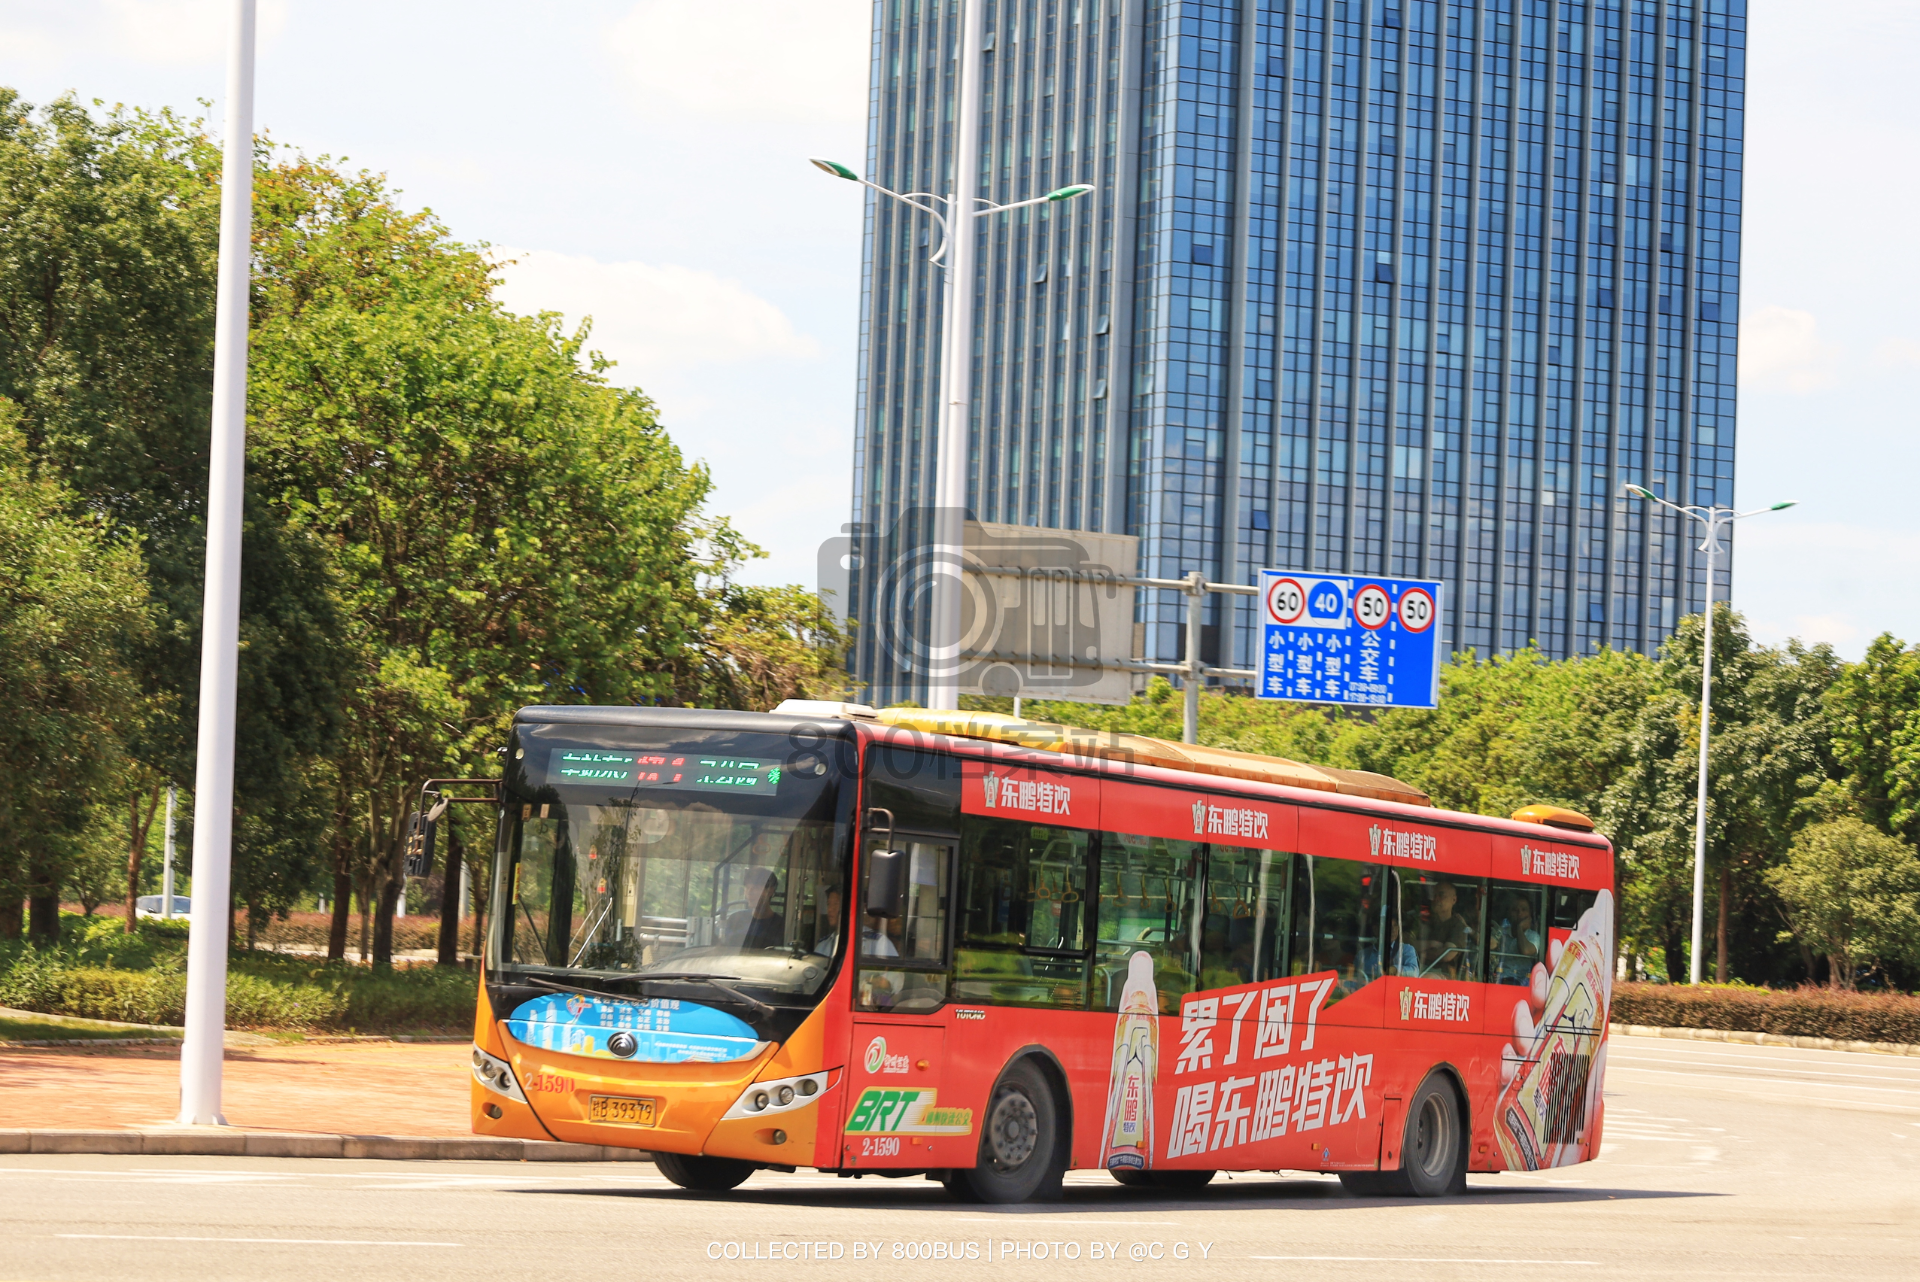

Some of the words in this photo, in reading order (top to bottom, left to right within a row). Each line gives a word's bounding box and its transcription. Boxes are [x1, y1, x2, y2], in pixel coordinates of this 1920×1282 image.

[1277, 591, 1299, 612] 60
[1314, 593, 1338, 612] 40
[1362, 597, 1384, 618] 50
[1406, 600, 1427, 620] 50
[1267, 630, 1285, 694] 小型车
[1295, 632, 1314, 696] 小型车
[1323, 634, 1342, 698] 小型车
[1358, 630, 1381, 682] 公交车
[1001, 776, 1071, 816] 东鹏特饮
[1207, 804, 1269, 840] 东鹏特饮
[1382, 828, 1437, 862] 东鹏特饮
[1532, 848, 1580, 880] 东鹏特饮
[1413, 990, 1470, 1022] 东鹏特饮
[1175, 977, 1334, 1075] 累了困了
[524, 1072, 576, 1093] 2-1590
[1123, 1075, 1140, 1122] 东鹏
[846, 1090, 920, 1132] BRT
[1167, 1051, 1373, 1159] 喝东鹏特饮
[862, 1137, 900, 1157] 2-1590
